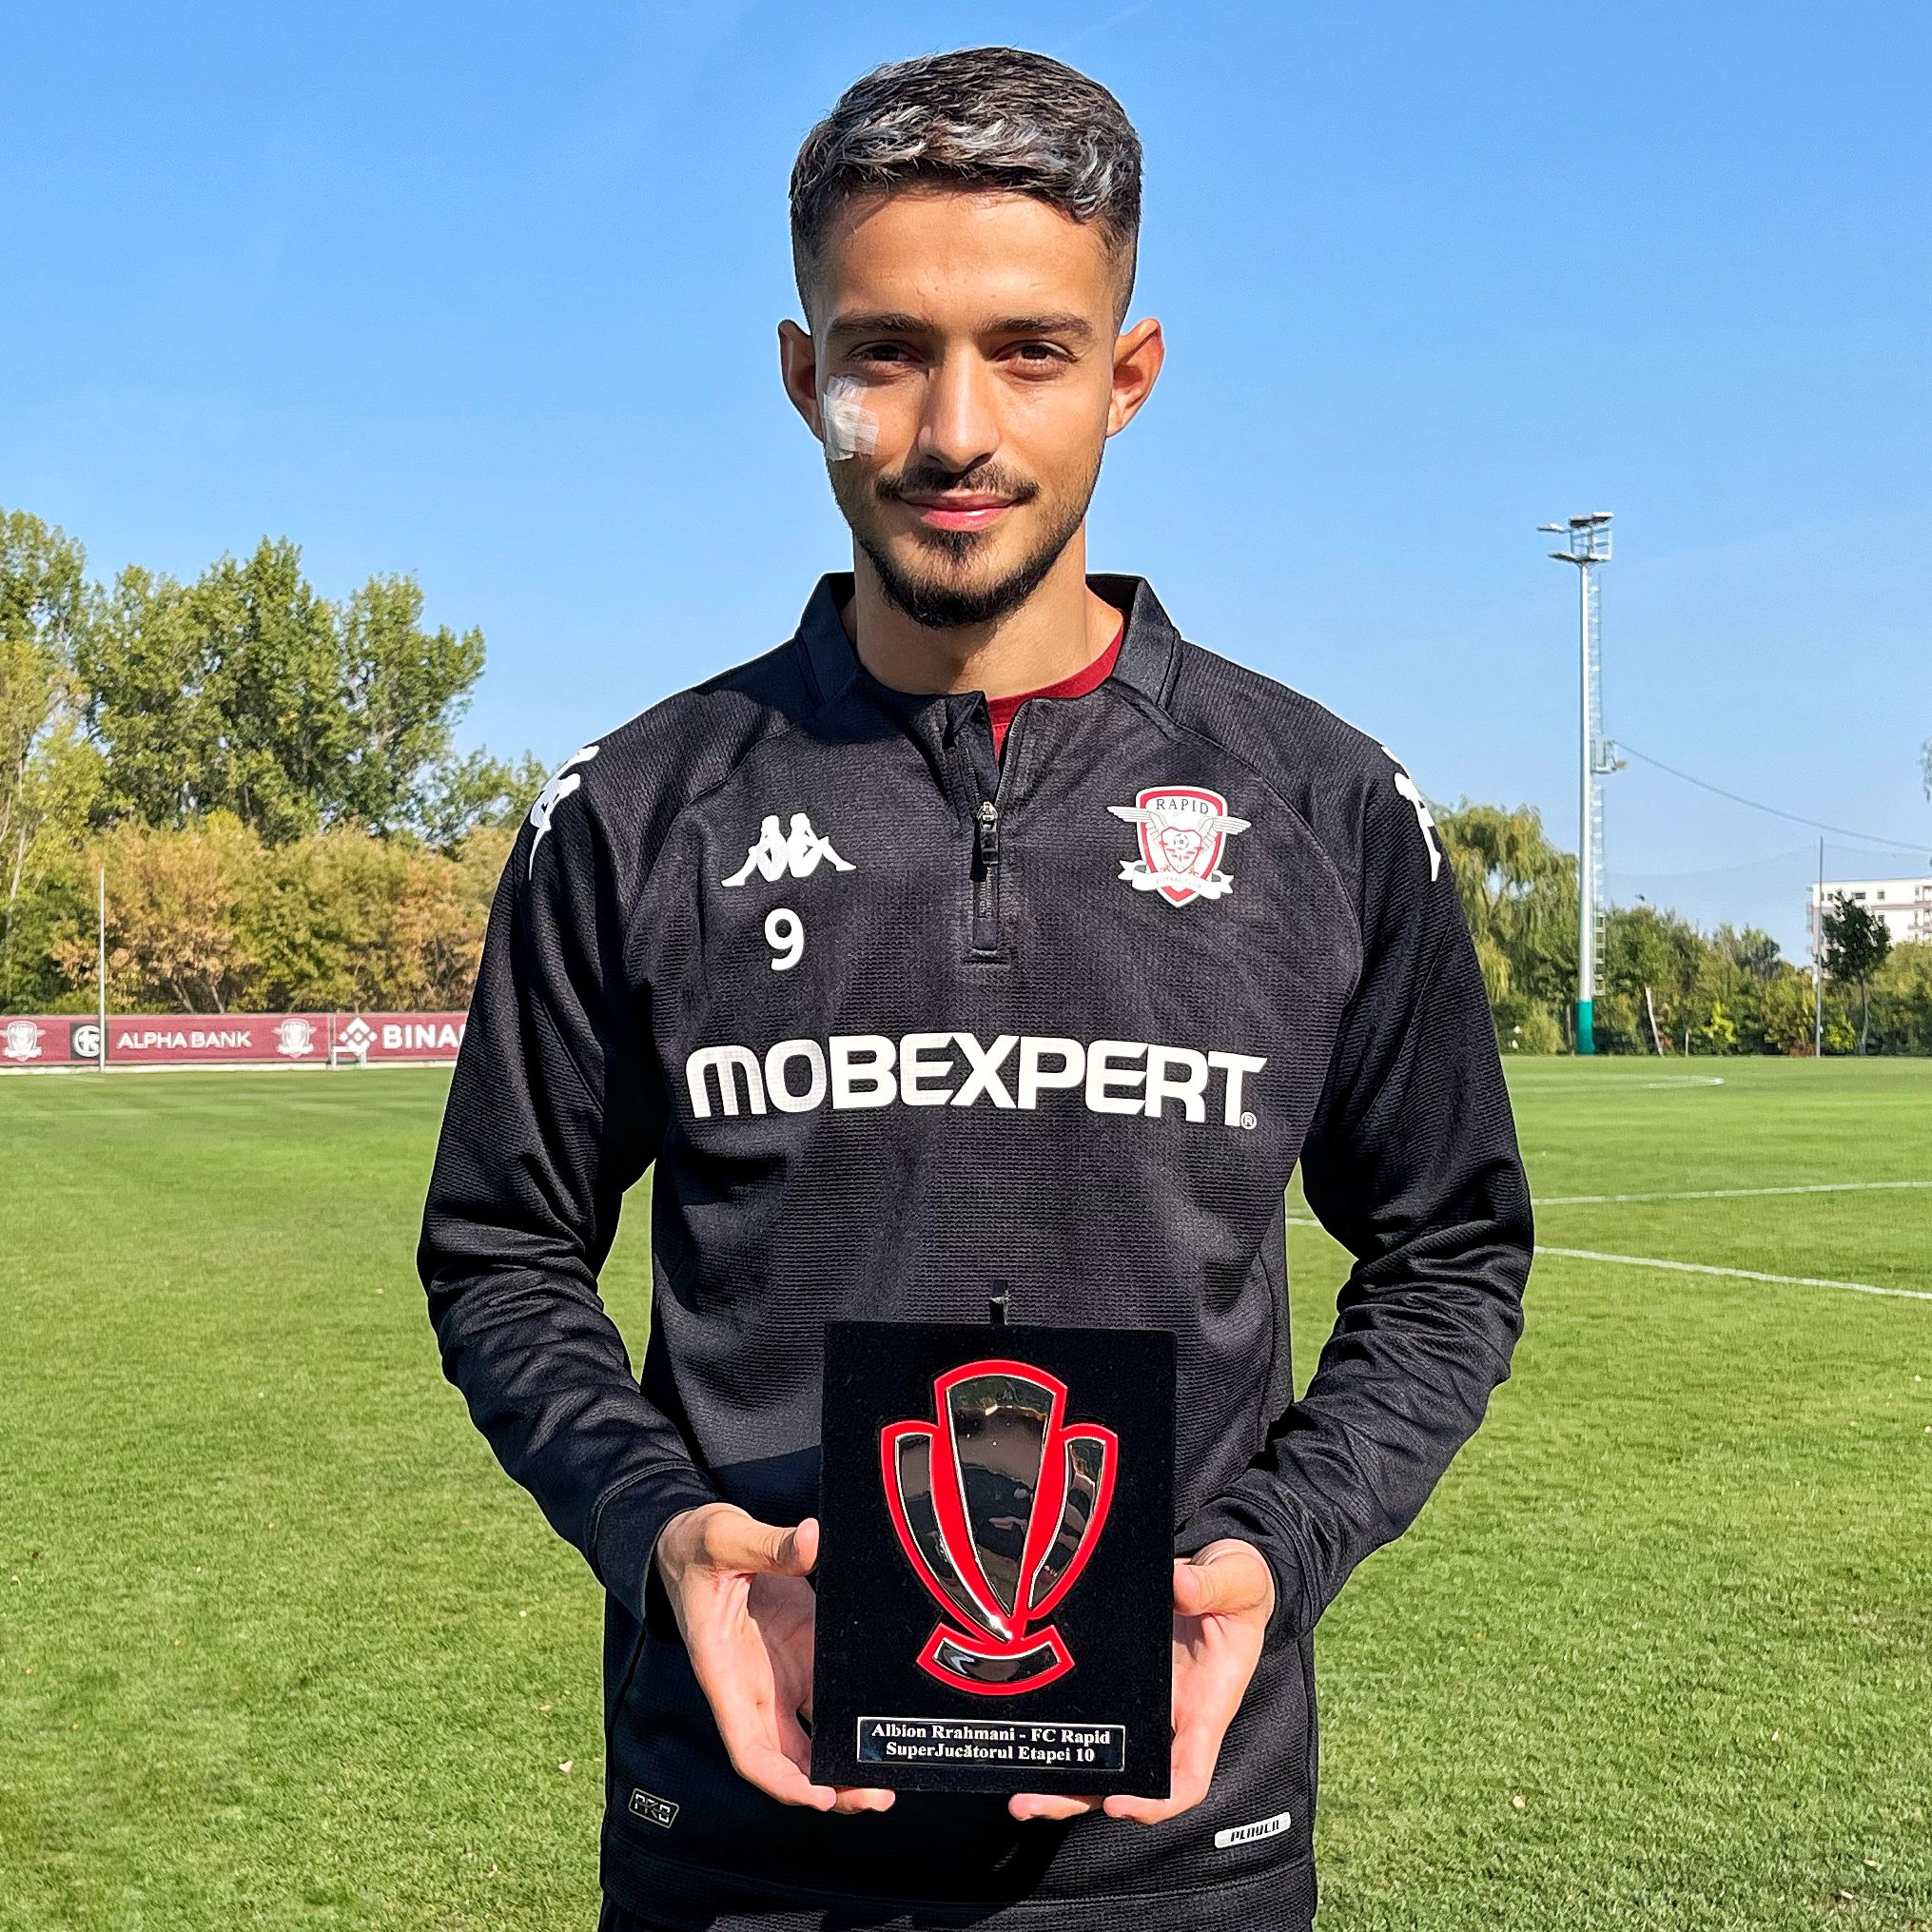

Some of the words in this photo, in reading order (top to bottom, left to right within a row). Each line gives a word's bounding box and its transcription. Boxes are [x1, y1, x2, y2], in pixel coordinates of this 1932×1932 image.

[1156, 798, 1210, 815] RAPID
[764, 907, 806, 971] 9
[116, 1031, 187, 1050] ALPHA
[190, 1029, 252, 1049] BANK
[382, 1024, 466, 1049] BINA
[871, 1723, 927, 1739] Albion
[931, 1725, 1015, 1742] Rrahmani
[1030, 1727, 1056, 1743] FC
[1061, 1728, 1110, 1747] Rapid
[886, 1741, 1013, 1760] SuperJucătorul
[1018, 1746, 1071, 1764] Etapei
[1076, 1747, 1095, 1762] 10
